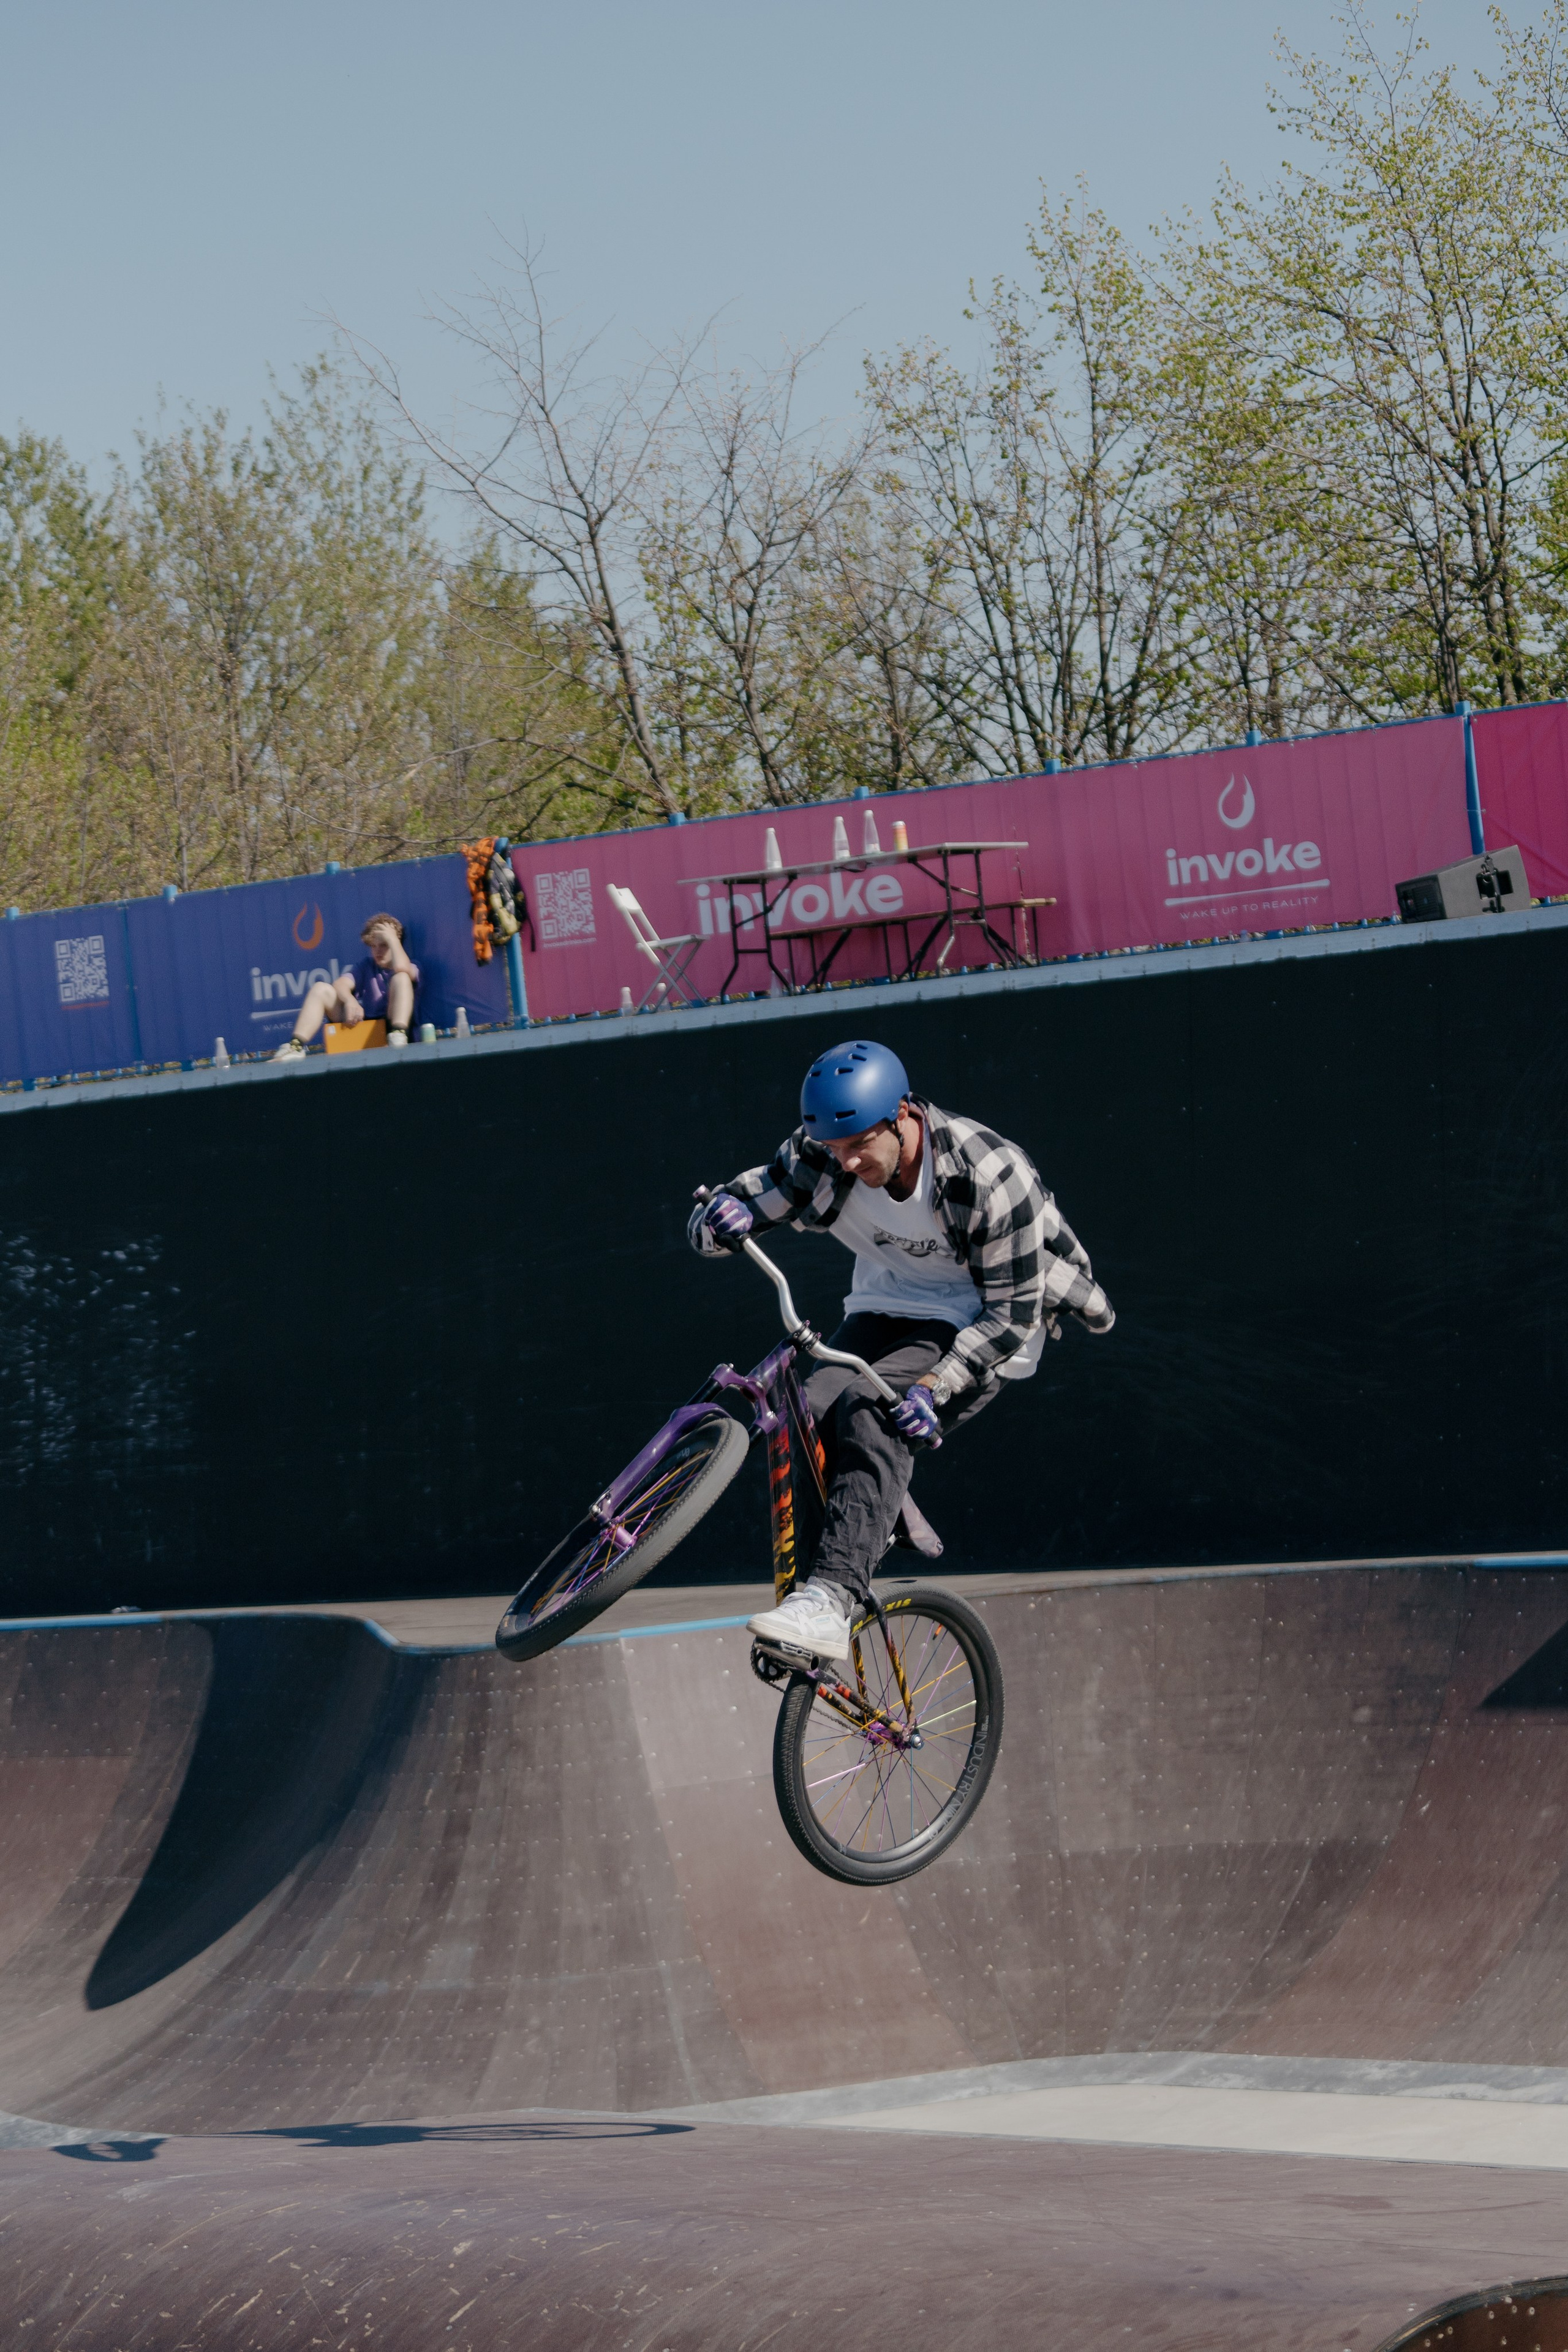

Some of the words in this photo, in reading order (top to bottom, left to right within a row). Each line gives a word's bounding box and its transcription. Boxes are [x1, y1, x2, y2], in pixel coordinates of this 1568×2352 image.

[1166, 837, 1321, 886] invoke
[696, 872, 903, 935] invoke
[1180, 908, 1217, 919] WAKE
[1222, 906, 1238, 915] UP
[1243, 903, 1259, 912] TO
[1263, 896, 1318, 910] REALITY
[956, 1732, 988, 1800] INDUSTRY
